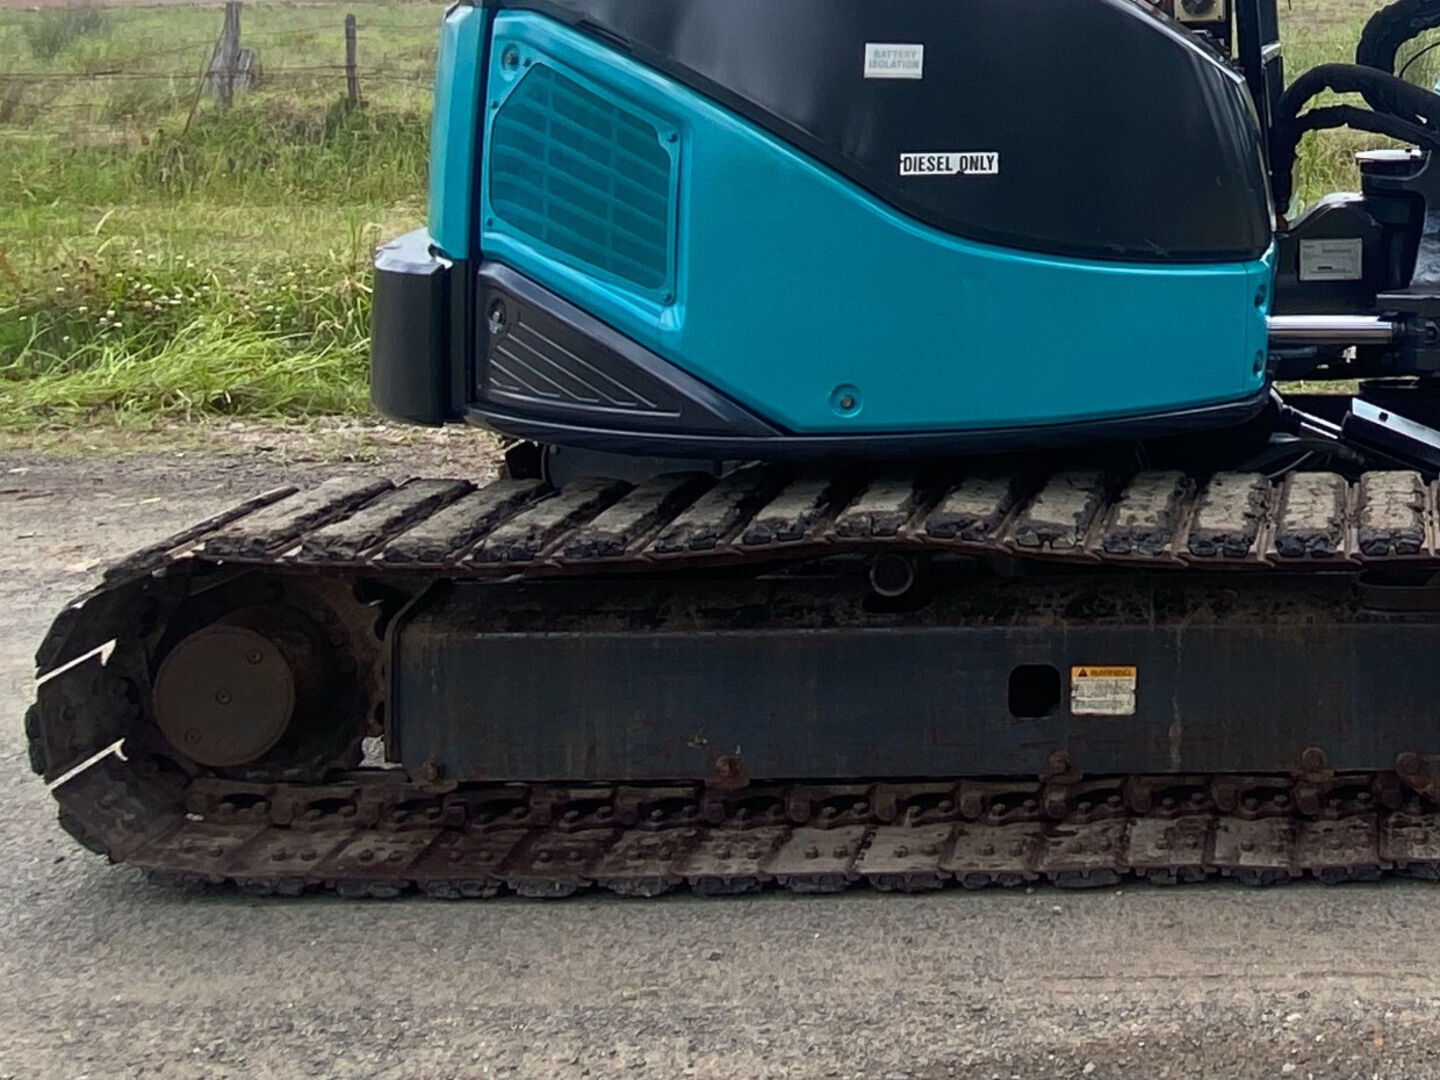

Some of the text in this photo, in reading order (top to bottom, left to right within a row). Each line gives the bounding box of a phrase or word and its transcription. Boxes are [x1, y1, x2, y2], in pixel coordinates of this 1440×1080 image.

[873, 50, 916, 59] BATTERY
[868, 59, 920, 69] ISOLATION
[902, 155, 995, 172] DIESEL ONLY
